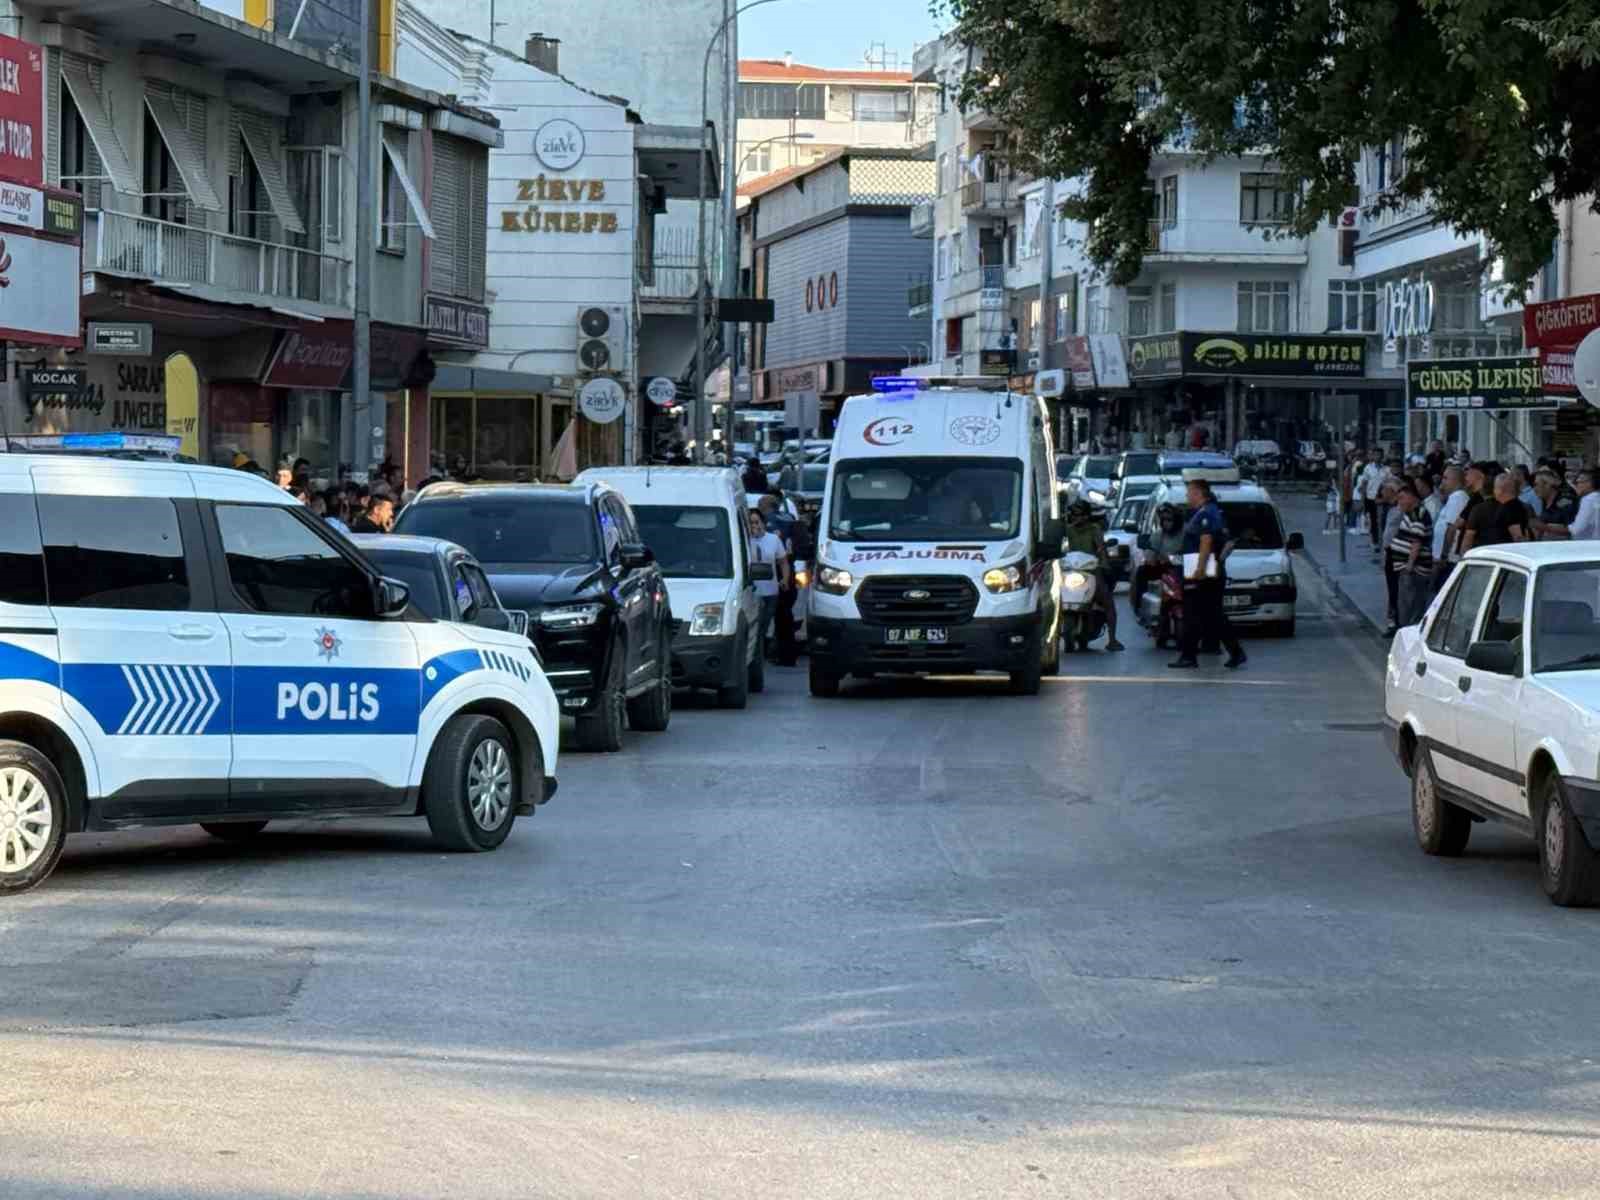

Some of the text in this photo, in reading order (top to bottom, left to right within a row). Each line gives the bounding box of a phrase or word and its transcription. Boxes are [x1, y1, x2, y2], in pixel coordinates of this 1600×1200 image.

[8, 119, 32, 161] TOUR
[516, 173, 606, 201] ZİRVE
[501, 205, 618, 233] KÜNEFE
[1254, 340, 1300, 360] BİZİM
[32, 373, 77, 386] KOCAK
[1420, 360, 1542, 394] GÜNEŞ İLETİŞİ
[875, 424, 914, 437] 112
